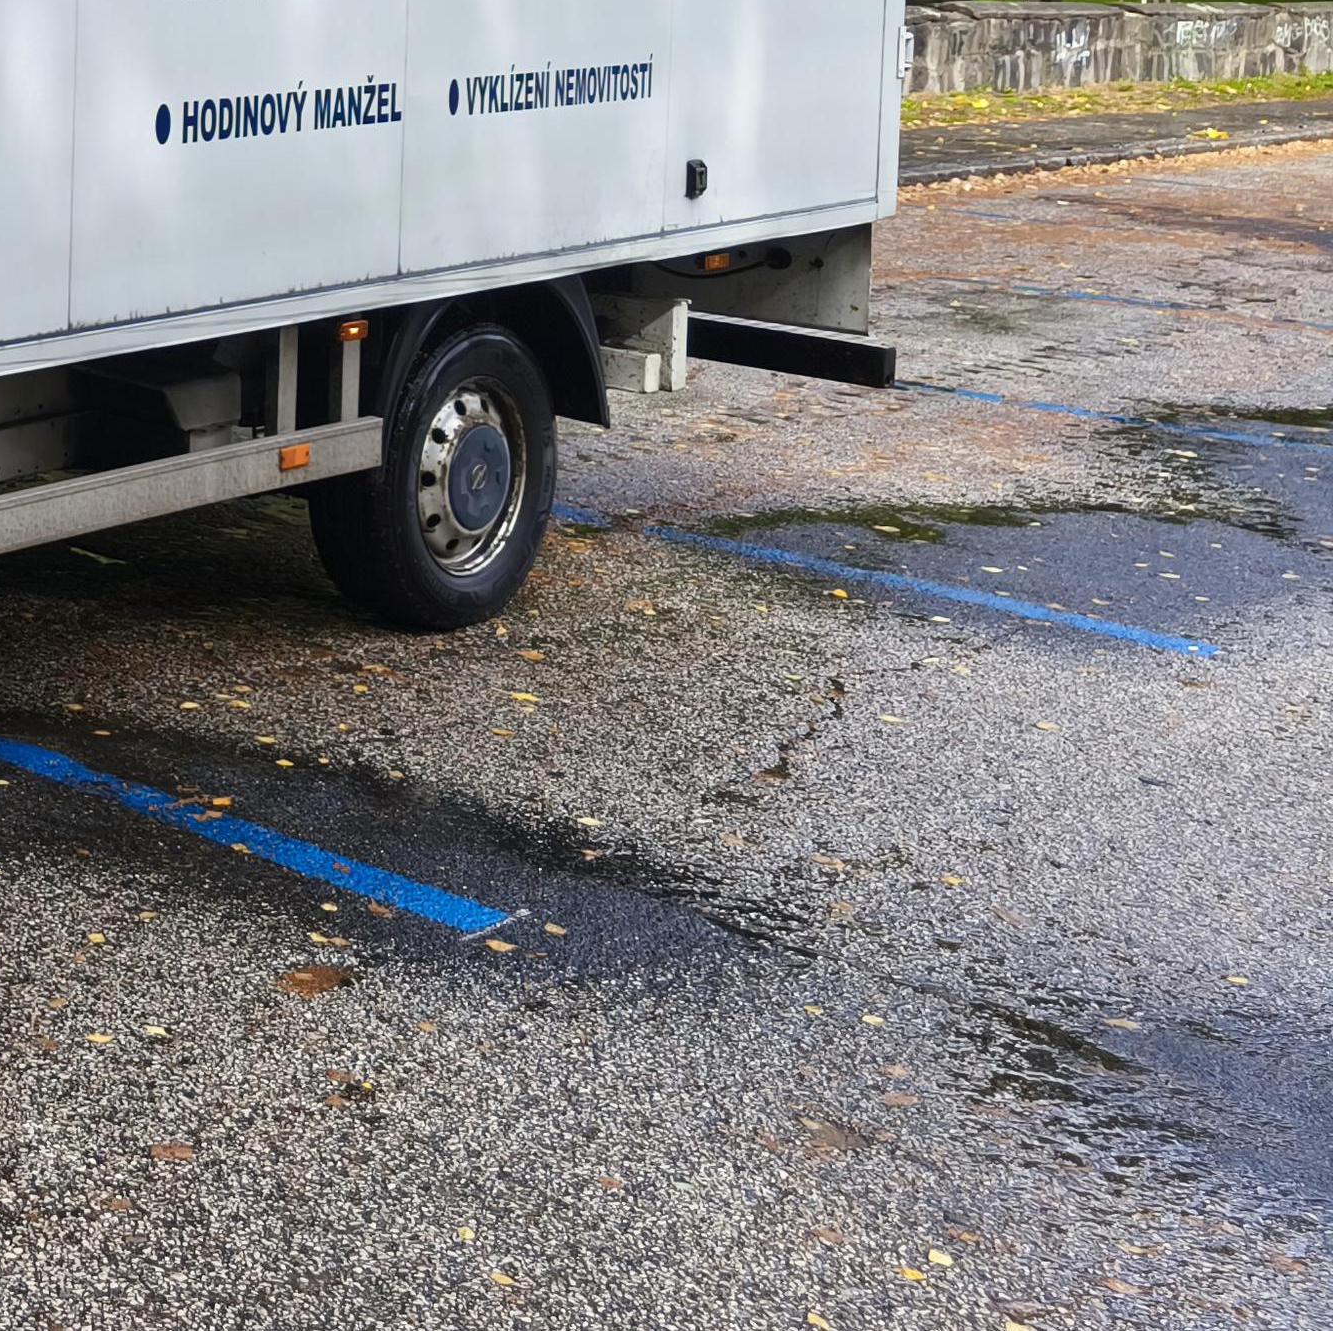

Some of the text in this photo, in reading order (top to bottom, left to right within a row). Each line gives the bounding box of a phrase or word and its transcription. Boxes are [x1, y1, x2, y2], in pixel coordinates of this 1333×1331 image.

[182, 75, 402, 144] HODINOVÝ MANŽEL
[466, 53, 653, 116] VYKLÍZENÍ NEMOVITOSTÍ
